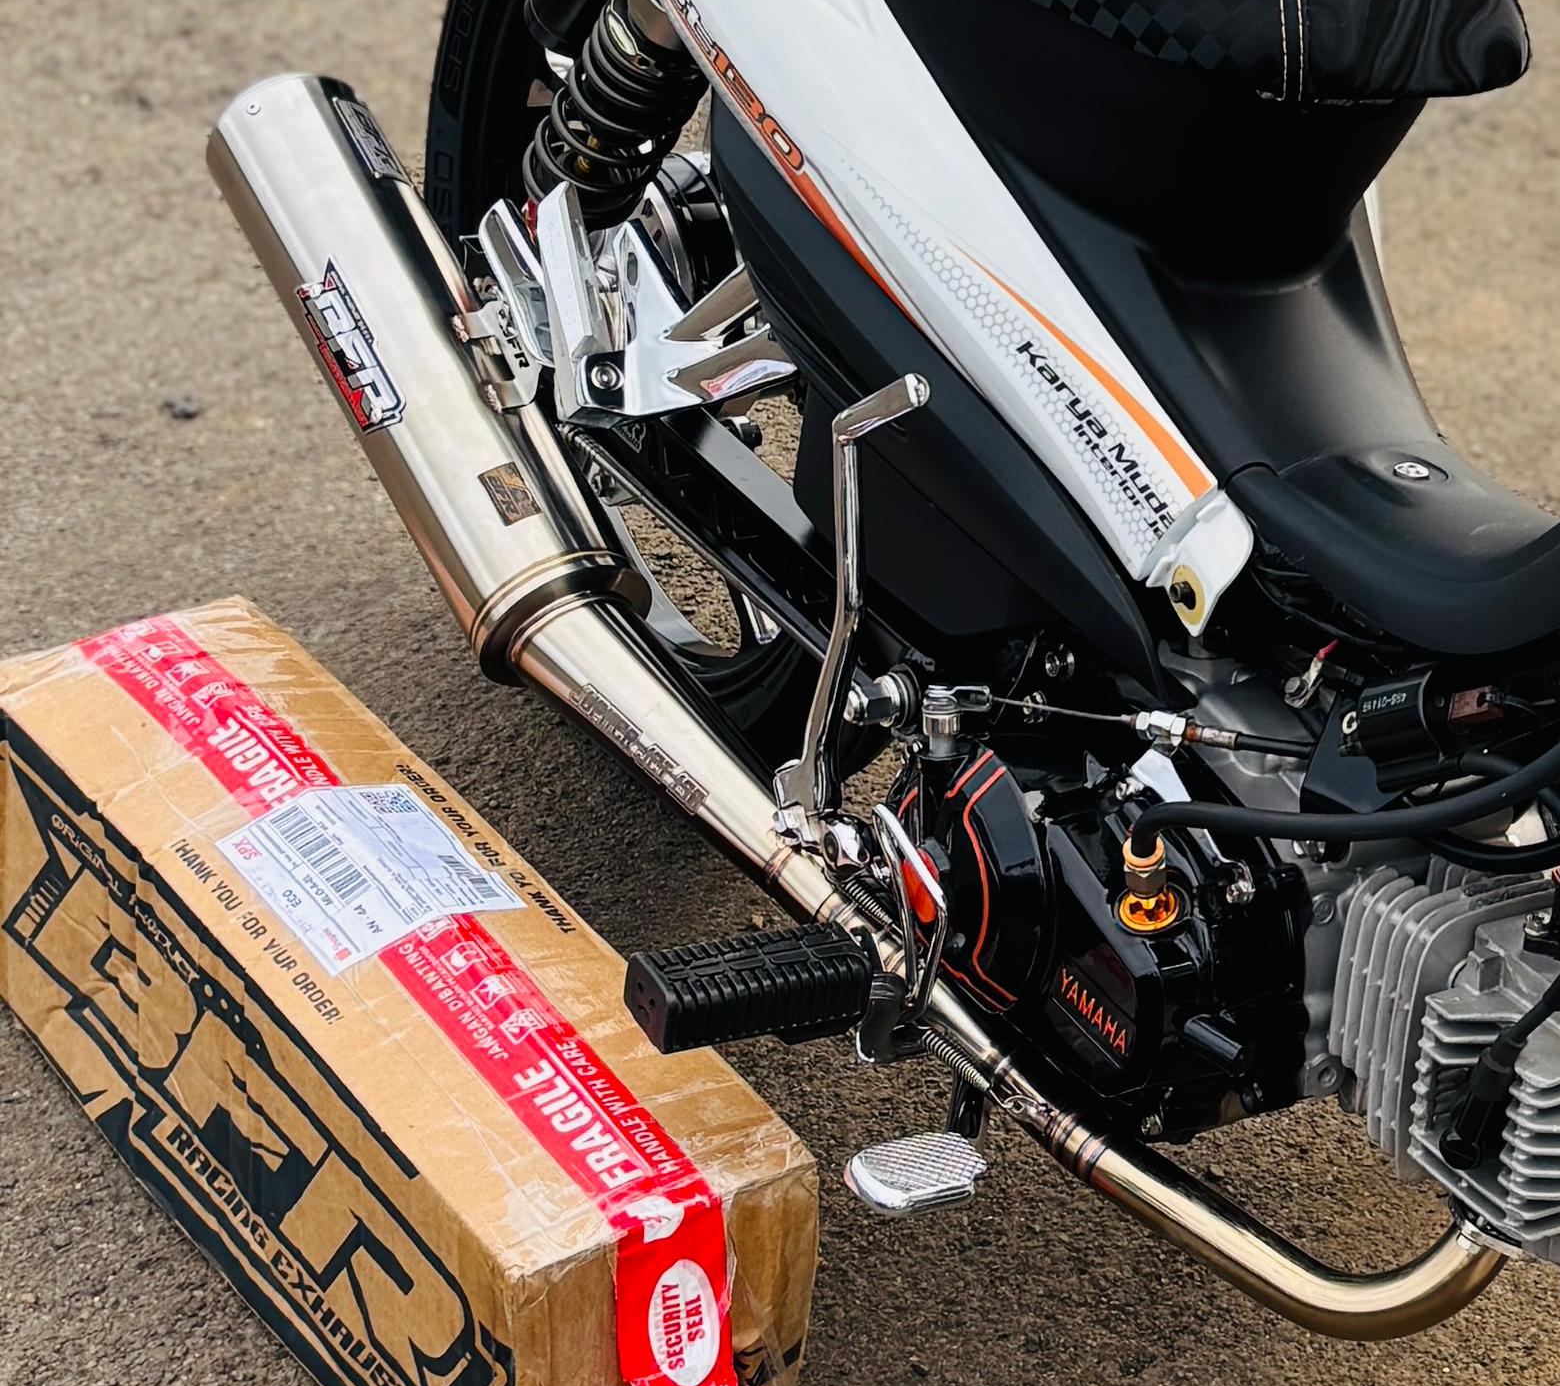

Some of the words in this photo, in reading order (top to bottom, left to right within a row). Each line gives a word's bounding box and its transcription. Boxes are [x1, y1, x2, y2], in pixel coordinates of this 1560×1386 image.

[1016, 341, 1108, 439] Karya
[1073, 424, 1145, 510] Interior
[442, 806, 480, 839] YOUR
[475, 841, 507, 869] FOR
[527, 890, 577, 934] THANK
[211, 880, 243, 913] YOU
[291, 971, 345, 1026] ORDER!
[399, 940, 464, 1011] DIBANTING
[459, 1013, 510, 1061] JANGAN
[1059, 965, 1131, 1056] YAMAHA
[555, 1040, 598, 1078] CARE
[512, 1058, 644, 1189] FRAGILE
[587, 1077, 638, 1117] WITH
[620, 1115, 679, 1175] HANDLE
[166, 1123, 270, 1253] RACING
[661, 1283, 687, 1371] SECURITY
[685, 1294, 707, 1344] SEAL
